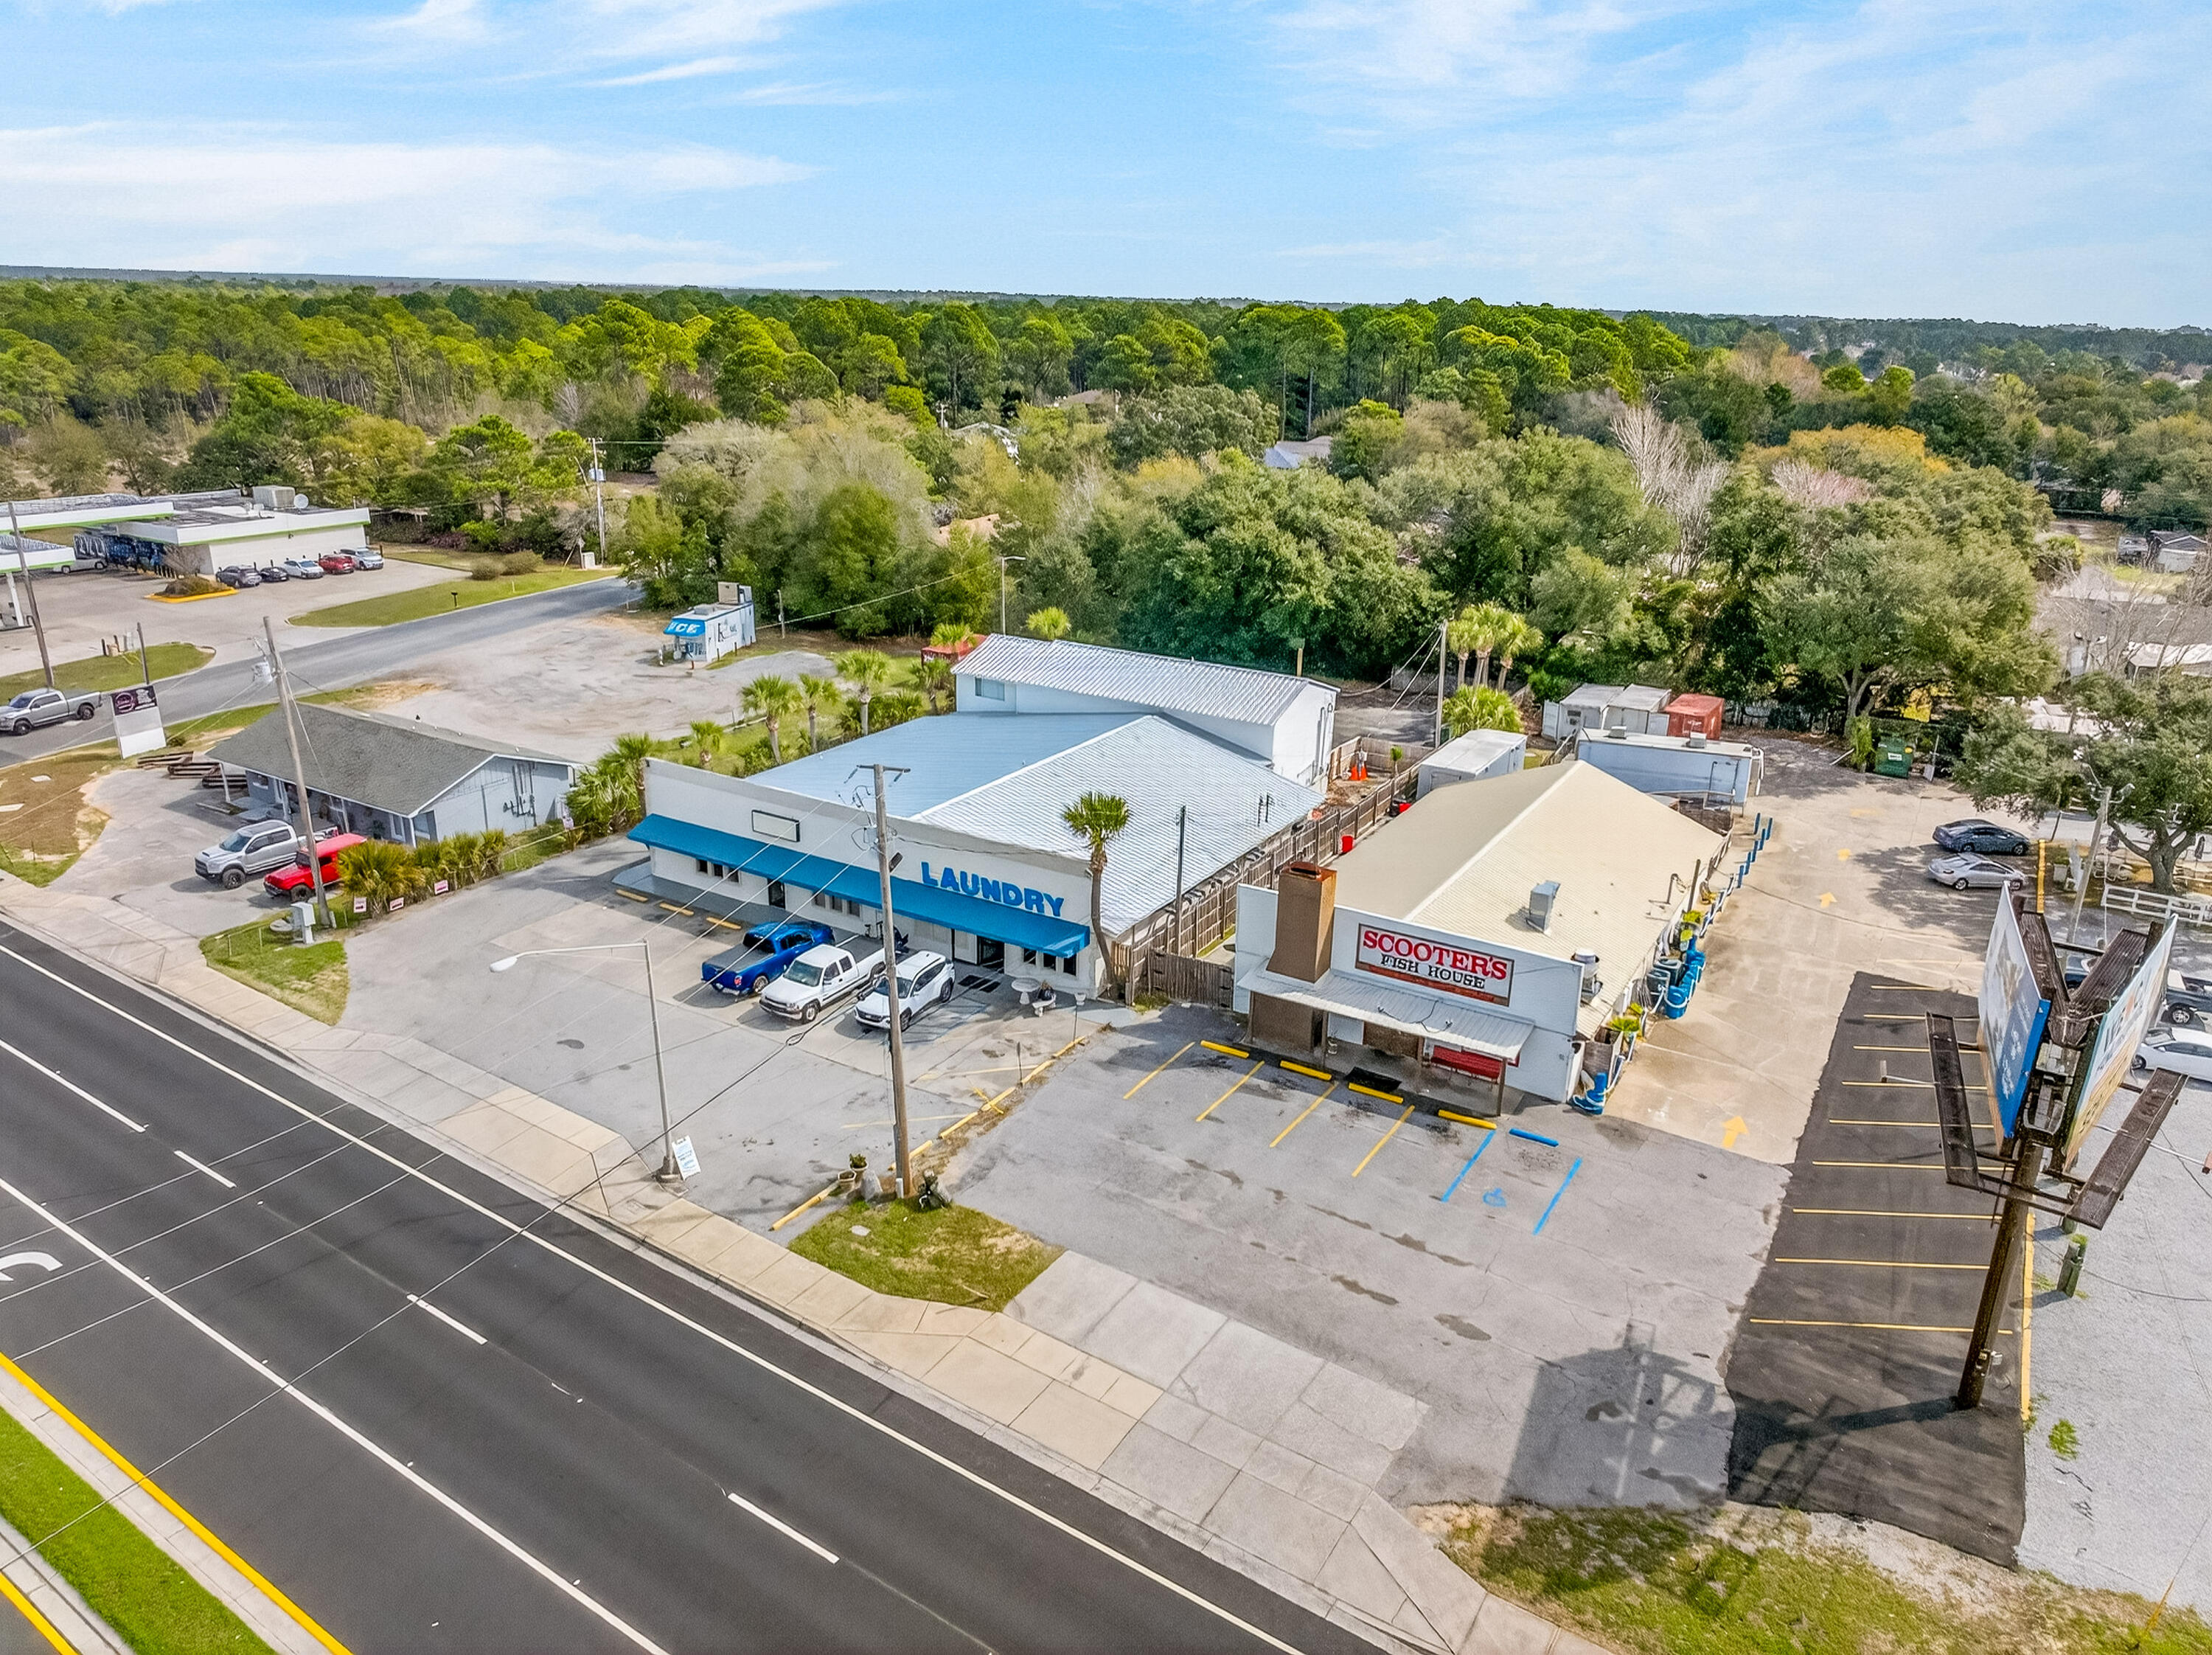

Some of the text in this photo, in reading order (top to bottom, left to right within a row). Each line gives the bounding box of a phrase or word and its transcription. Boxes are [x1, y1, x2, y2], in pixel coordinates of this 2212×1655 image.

[667, 622, 700, 634] ICE
[921, 861, 1065, 917] LAUNDRY
[1363, 930, 1507, 980] SCOOTER'S
[1381, 953, 1486, 990] FISH HOUSE
